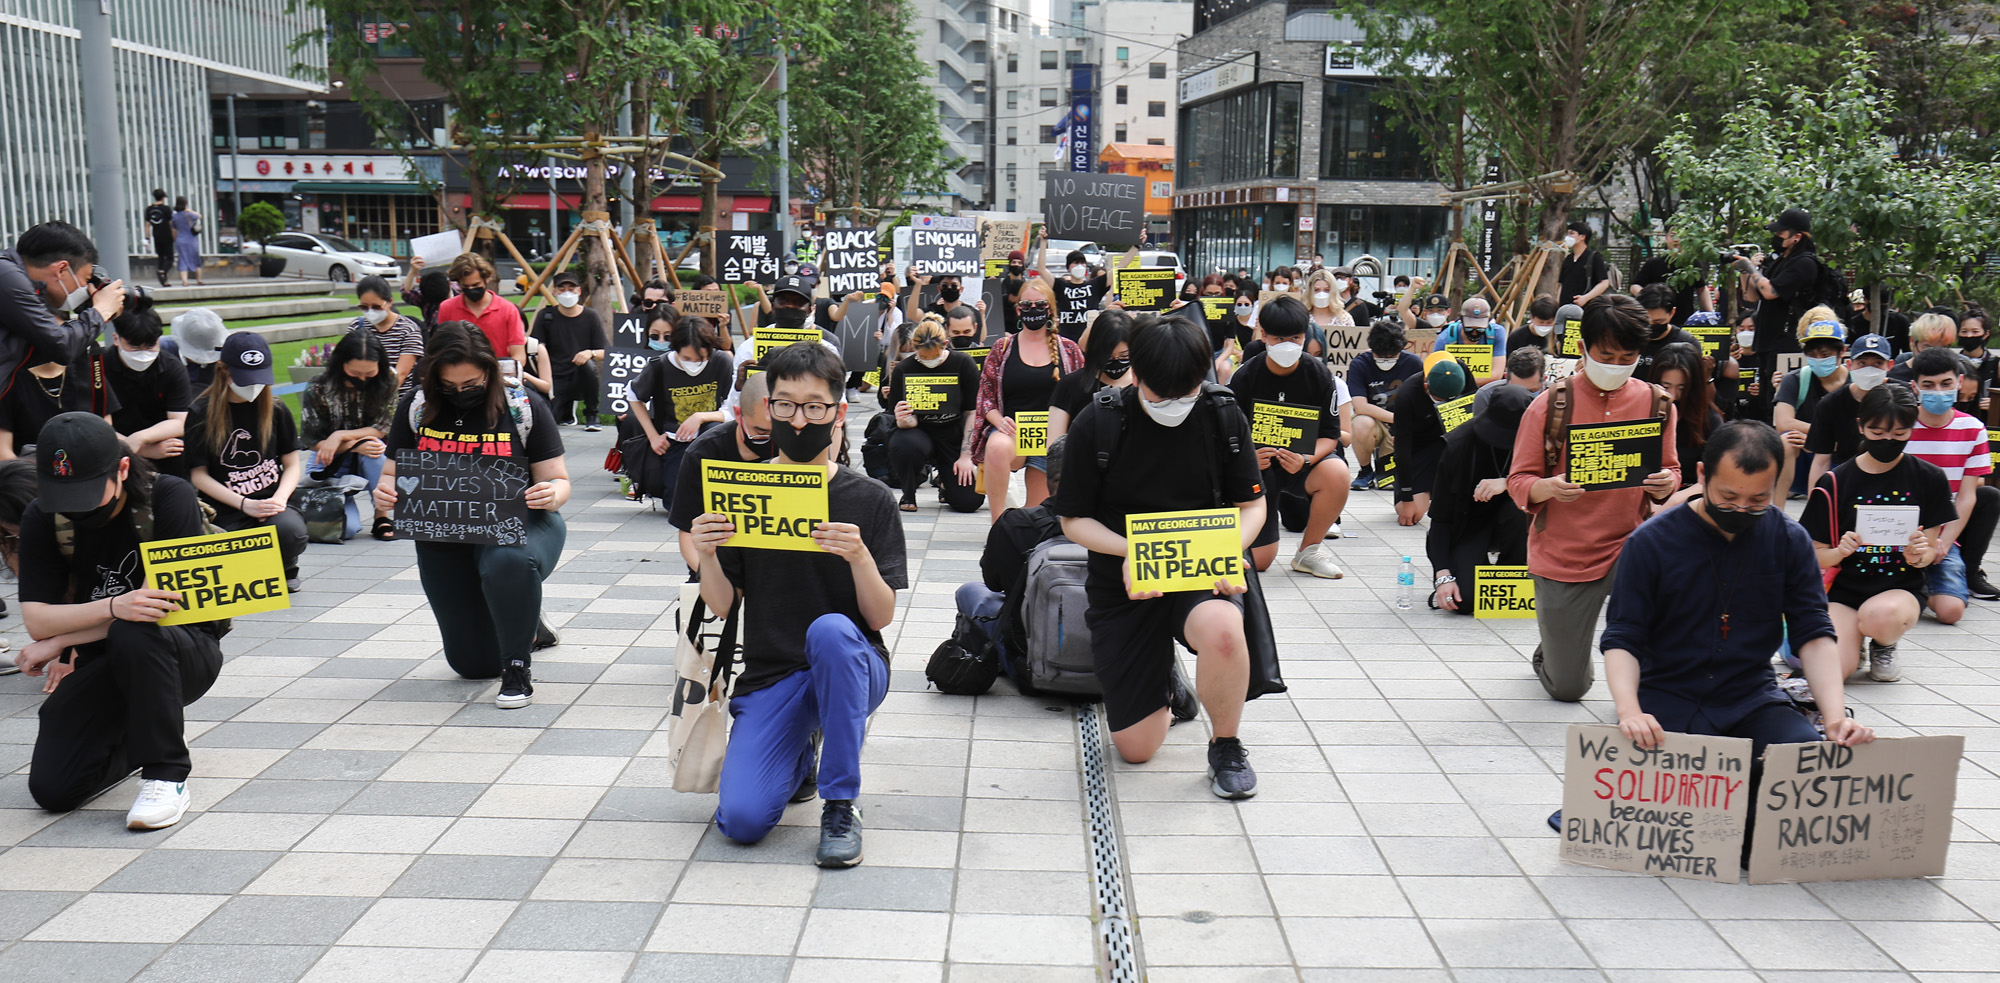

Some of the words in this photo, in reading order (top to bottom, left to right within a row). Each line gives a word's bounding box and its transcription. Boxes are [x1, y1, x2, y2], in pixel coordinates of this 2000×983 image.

[1074, 125, 1089, 172] 신한은
[1054, 178, 1076, 197] NO
[1084, 181, 1137, 200] JUSTICE
[1048, 203, 1078, 235] NO
[1081, 205, 1134, 231] PEACE
[729, 235, 770, 257] 제발,
[825, 229, 878, 251] BLACK
[914, 230, 977, 249] ENOUGH
[828, 250, 879, 270] LIVES
[938, 247, 955, 260] IS
[992, 250, 1010, 258] POWE
[724, 256, 780, 281] 숨막혀
[915, 260, 978, 274] ENOUGH
[829, 271, 881, 292] MATTER
[1064, 284, 1092, 299] REST
[682, 303, 722, 314] MATTER
[1070, 300, 1087, 310] IN
[1059, 311, 1088, 324] PEAC
[1324, 329, 1362, 350] OW
[93, 360, 103, 389] Canon
[1252, 413, 1284, 427] 우리는
[1266, 407, 1293, 416] AGAINST
[1293, 410, 1319, 418] RACISM
[458, 434, 479, 443] ASK
[481, 433, 495, 442] TO
[497, 432, 511, 442] BE
[1020, 427, 1048, 438] REST
[1251, 432, 1292, 448] 반대한다
[1252, 423, 1303, 440] 인종차별에
[1571, 432, 1586, 441] WE
[1588, 430, 1626, 440] AGAINST
[1627, 426, 1660, 436] RACISM
[1020, 438, 1033, 449] IN
[1570, 442, 1614, 458] 우리는
[397, 451, 483, 473] #BLACK
[1570, 452, 1642, 472] 인종차별에
[421, 474, 481, 494] LIVES
[708, 469, 734, 481] MAY
[735, 472, 782, 484] GEORGE
[782, 474, 821, 485] FLOYD
[1570, 468, 1628, 486] 반대한다
[402, 498, 499, 521] MATTER
[711, 491, 772, 514] REST
[484, 516, 523, 539] KOREA
[1132, 521, 1157, 532] MAY
[1157, 519, 1199, 530] GEORGE
[1200, 516, 1235, 527] FLOYD
[150, 549, 178, 561] MAY
[180, 542, 230, 558] GEORGE
[231, 535, 272, 551] FLOYD
[1135, 539, 1191, 561] REST
[1136, 561, 1160, 581] IN
[1166, 556, 1239, 579] PEACE
[1870, 556, 1891, 564] ALL
[155, 564, 223, 592] REST
[195, 577, 282, 609] PEACE
[1480, 584, 1517, 598] REST
[1479, 597, 1494, 611] IN
[1498, 597, 1536, 611] PEAC
[1579, 732, 1619, 762] We
[1629, 741, 1707, 771] Stand
[1718, 752, 1742, 772] in
[1797, 742, 1853, 774] END
[1594, 767, 1743, 810] SOLIDARITY
[1767, 773, 1915, 811] SYSTEMIC
[1610, 800, 1694, 828] because
[1567, 818, 1631, 848] BLACK
[1637, 825, 1695, 855] LIVES
[1778, 813, 1871, 850] RACISM
[1645, 853, 1718, 878] MATTER
